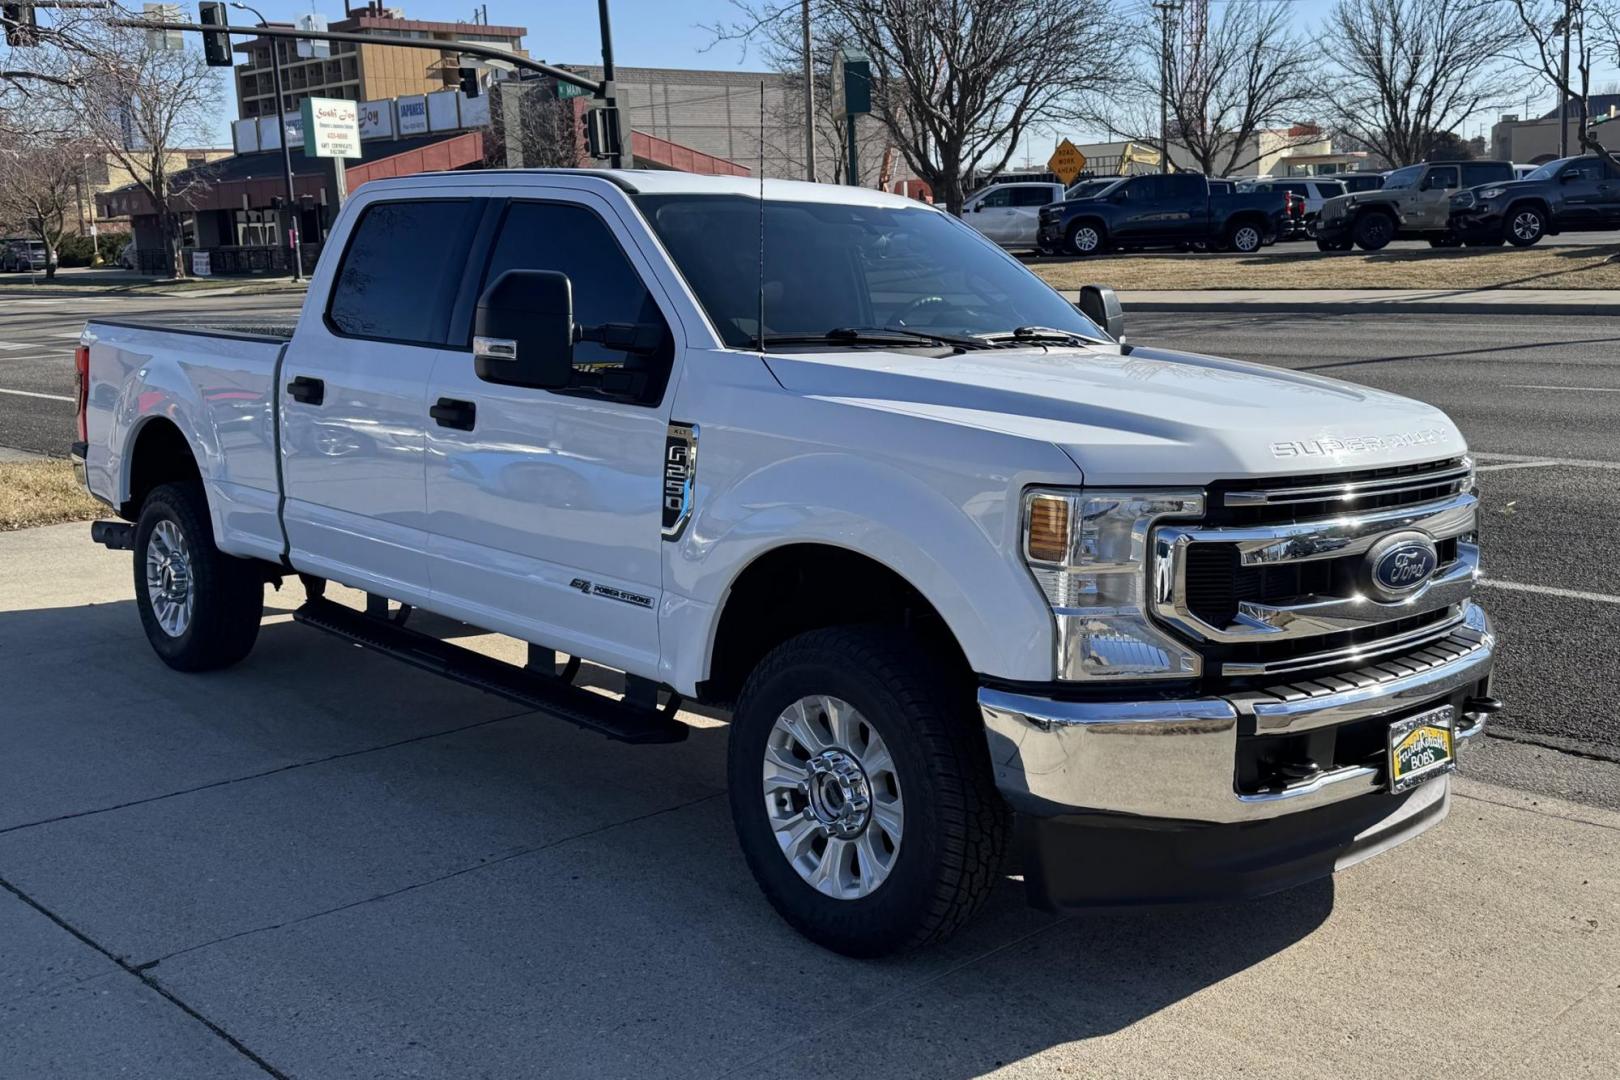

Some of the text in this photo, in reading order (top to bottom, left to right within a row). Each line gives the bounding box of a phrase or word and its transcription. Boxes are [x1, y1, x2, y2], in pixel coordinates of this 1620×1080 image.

[316, 107, 355, 122] Sushi Joy
[358, 107, 379, 128] Joy
[1057, 166, 1077, 174] AHEAD
[1271, 427, 1449, 458] SUPER DUTY
[1390, 551, 1427, 583] Ford
[594, 584, 652, 605] POWER STROKE
[1410, 748, 1435, 769] BOB'S
